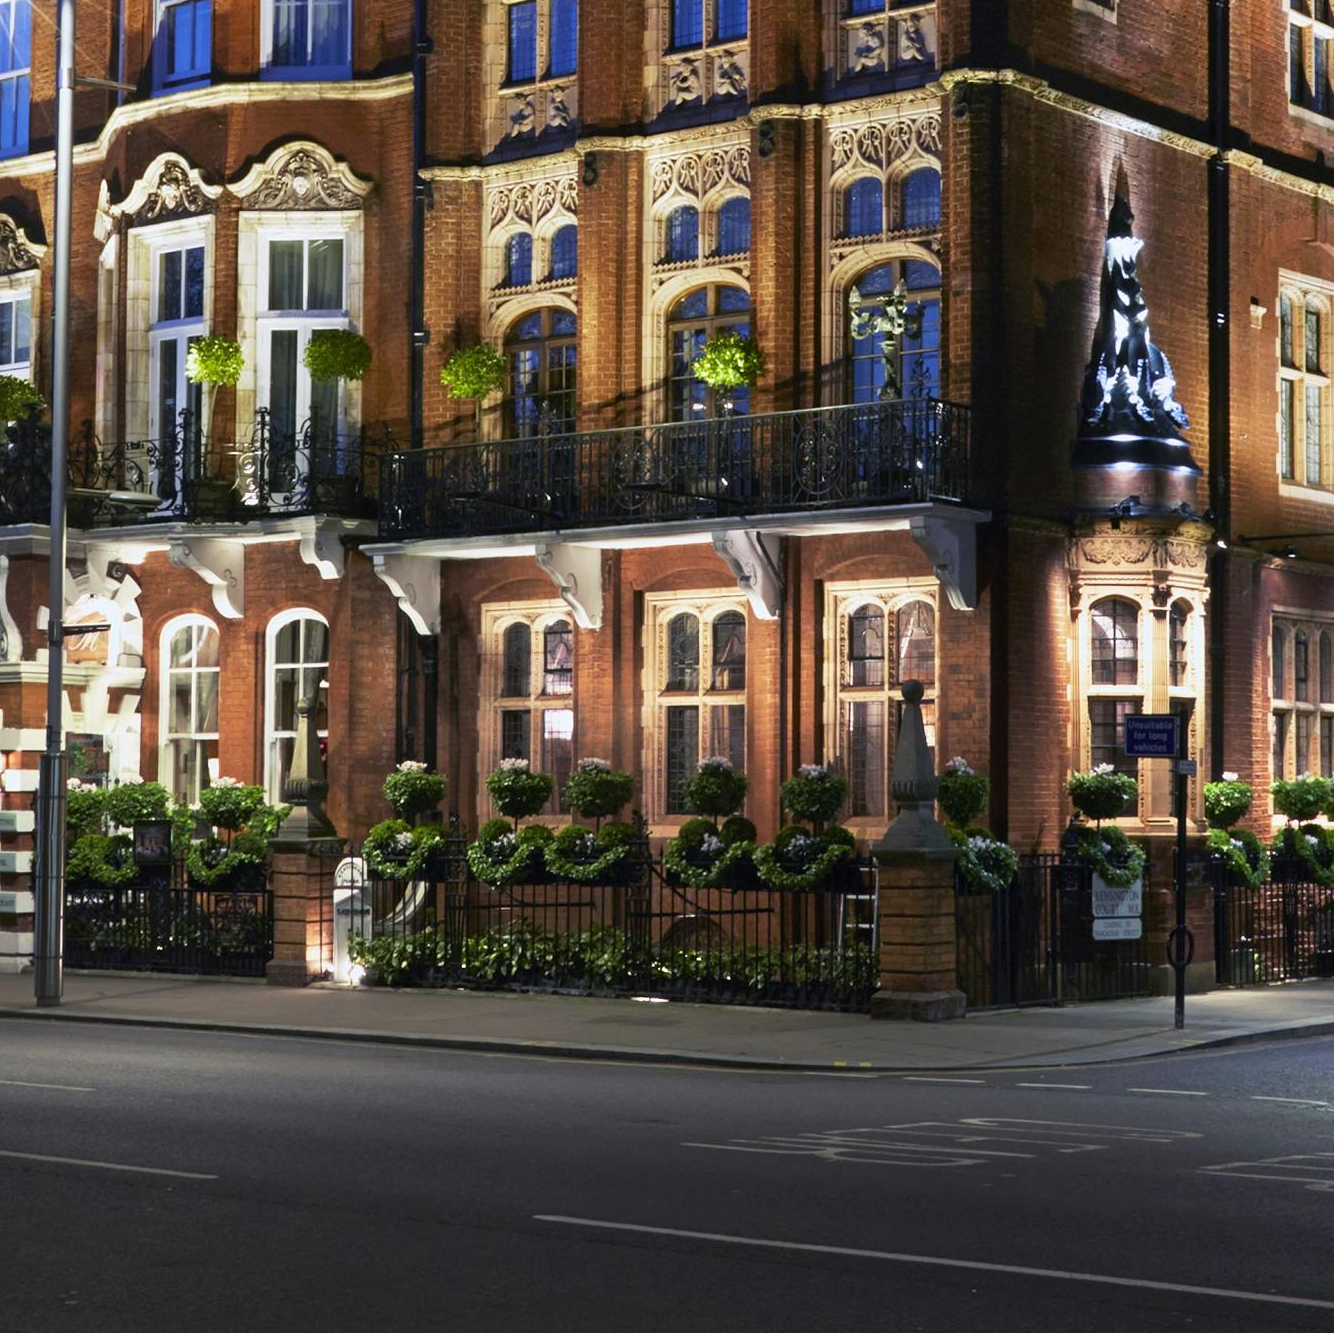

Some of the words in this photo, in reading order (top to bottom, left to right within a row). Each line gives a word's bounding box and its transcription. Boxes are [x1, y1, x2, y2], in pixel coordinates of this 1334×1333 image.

[1128, 719, 1173, 729] Unsuitable
[1133, 731, 1146, 740] for
[1149, 731, 1168, 742] long
[1133, 743, 1167, 752] vehicles
